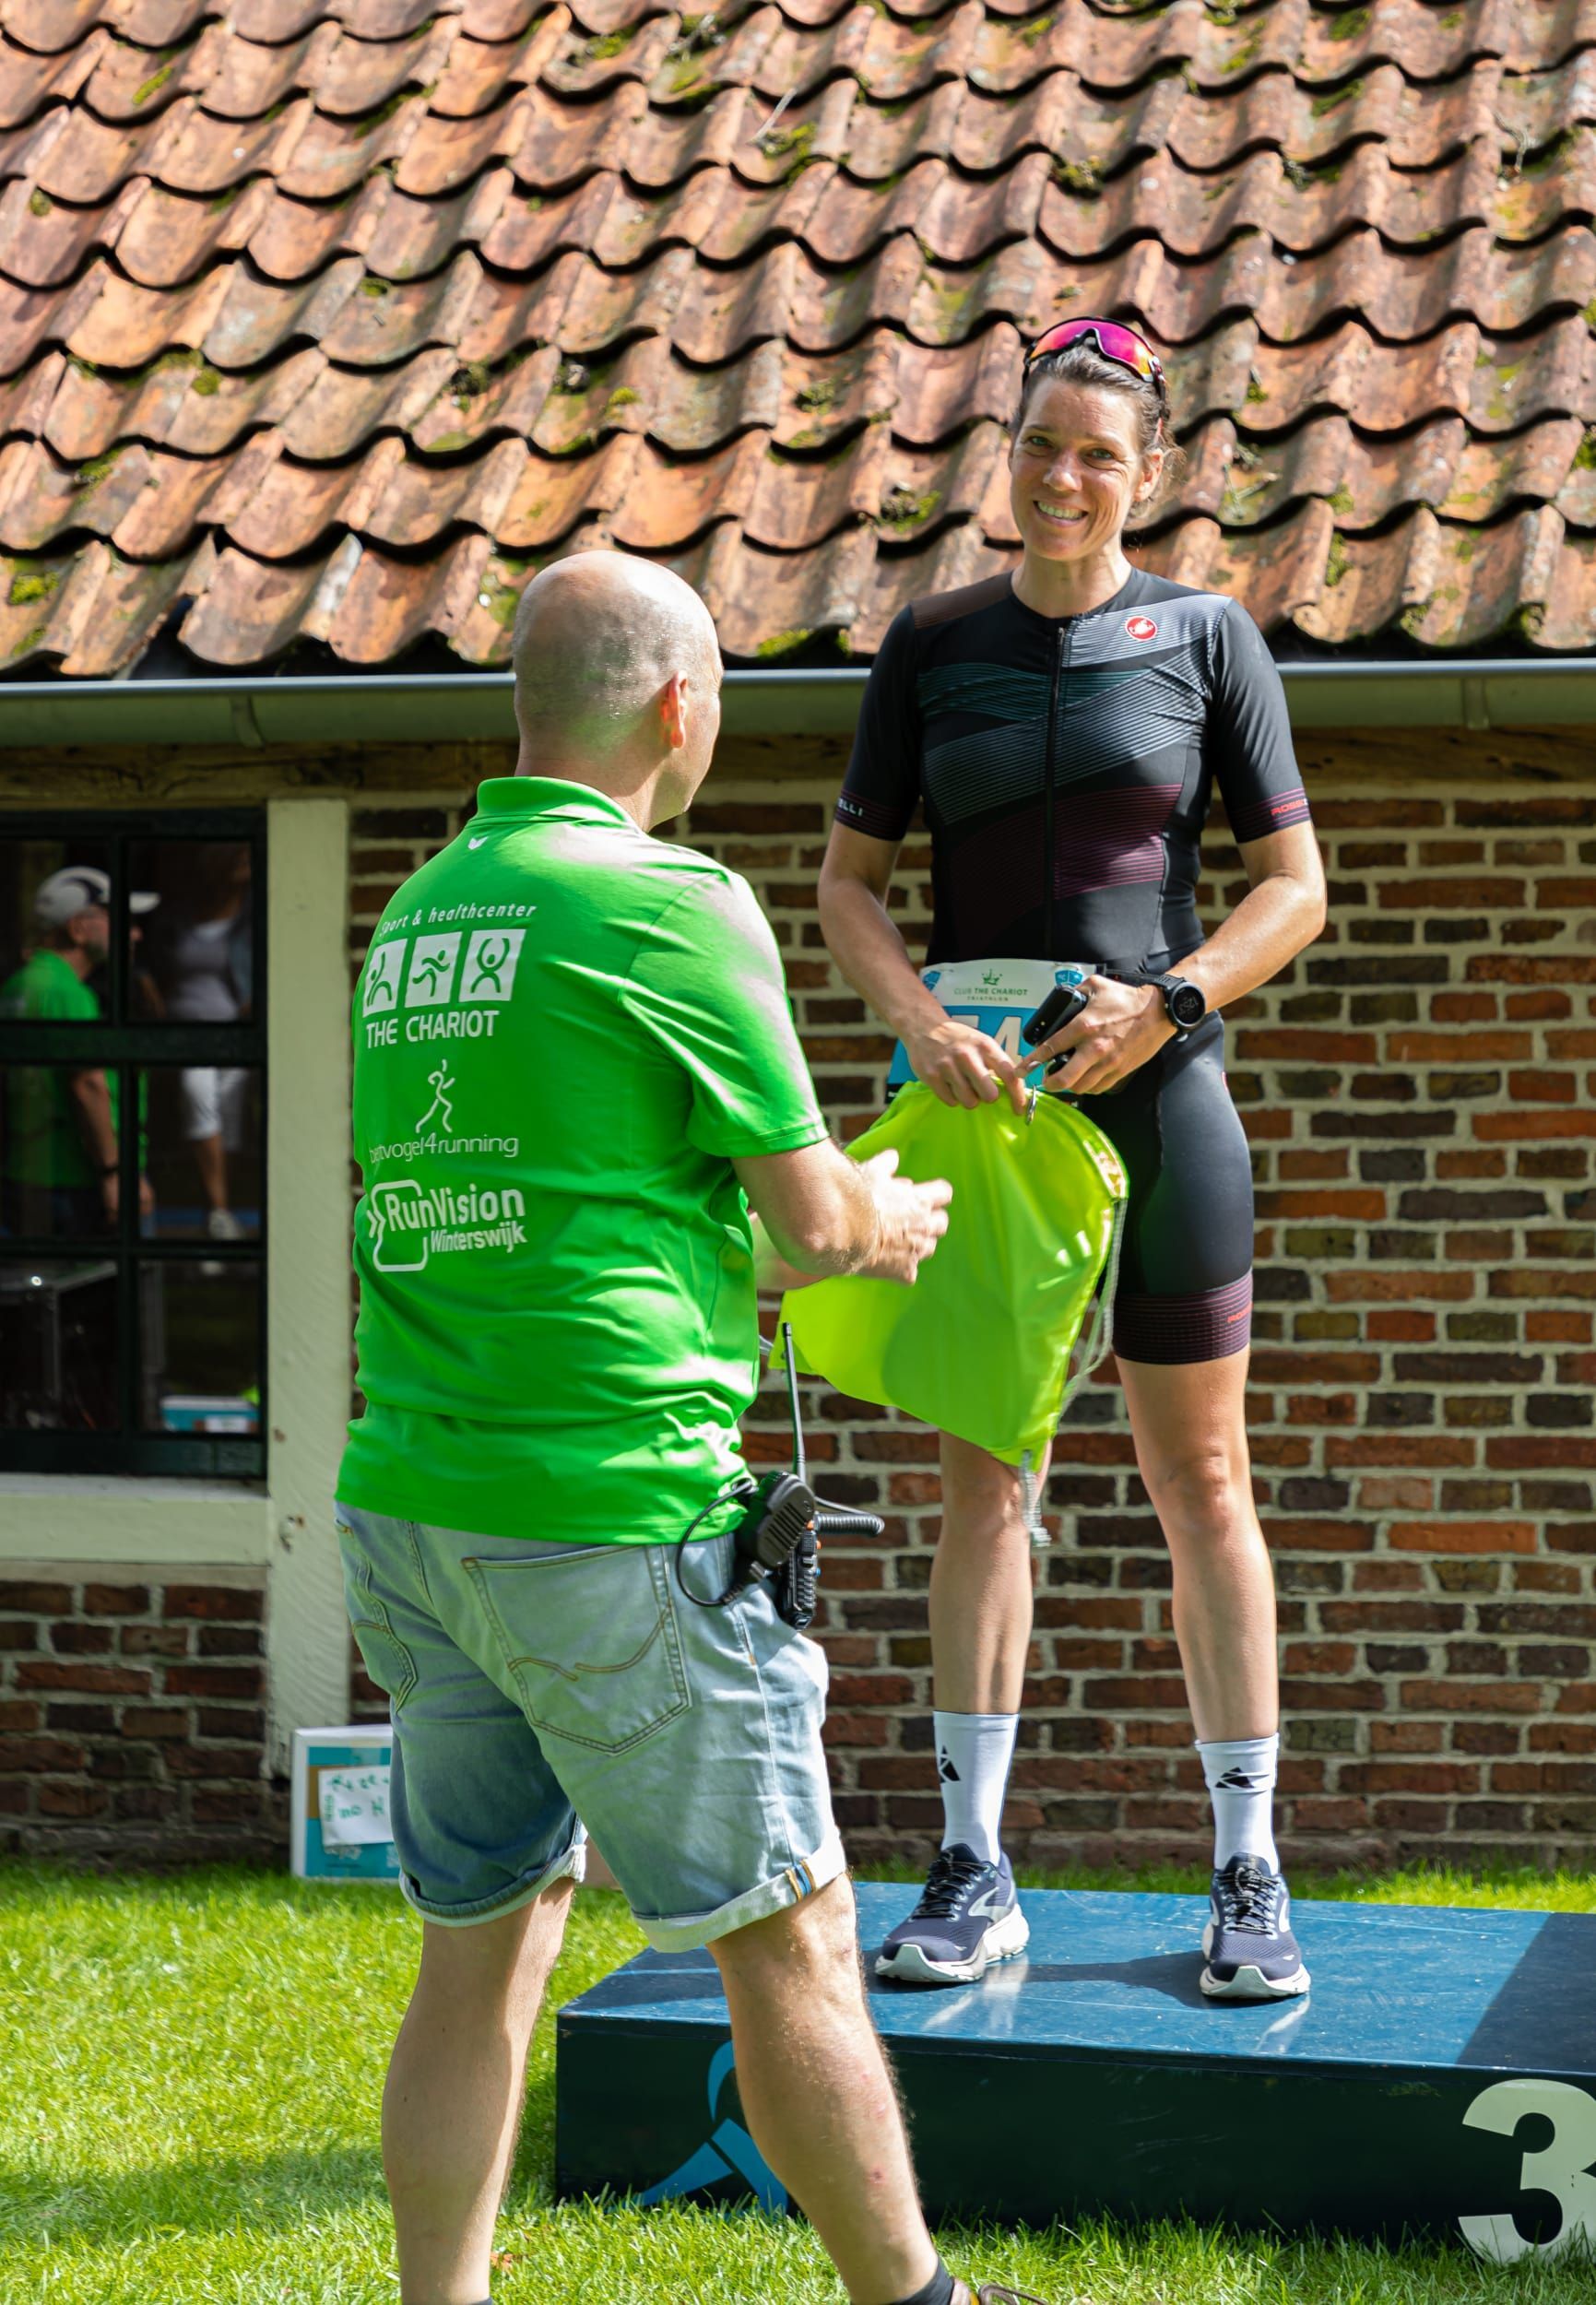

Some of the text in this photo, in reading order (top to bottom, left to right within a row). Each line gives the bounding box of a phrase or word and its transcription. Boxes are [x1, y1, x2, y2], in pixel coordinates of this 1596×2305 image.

[412, 909, 422, 926] &
[428, 903, 538, 924] healthcenter
[974, 987, 989, 996] THE
[990, 987, 1029, 997] CHARIOT
[366, 1010, 500, 1049] THE CHARIOT
[384, 1183, 526, 1232] RunVision
[431, 1220, 528, 1254] Winterswijk
[1458, 2078, 1596, 2265] 3
